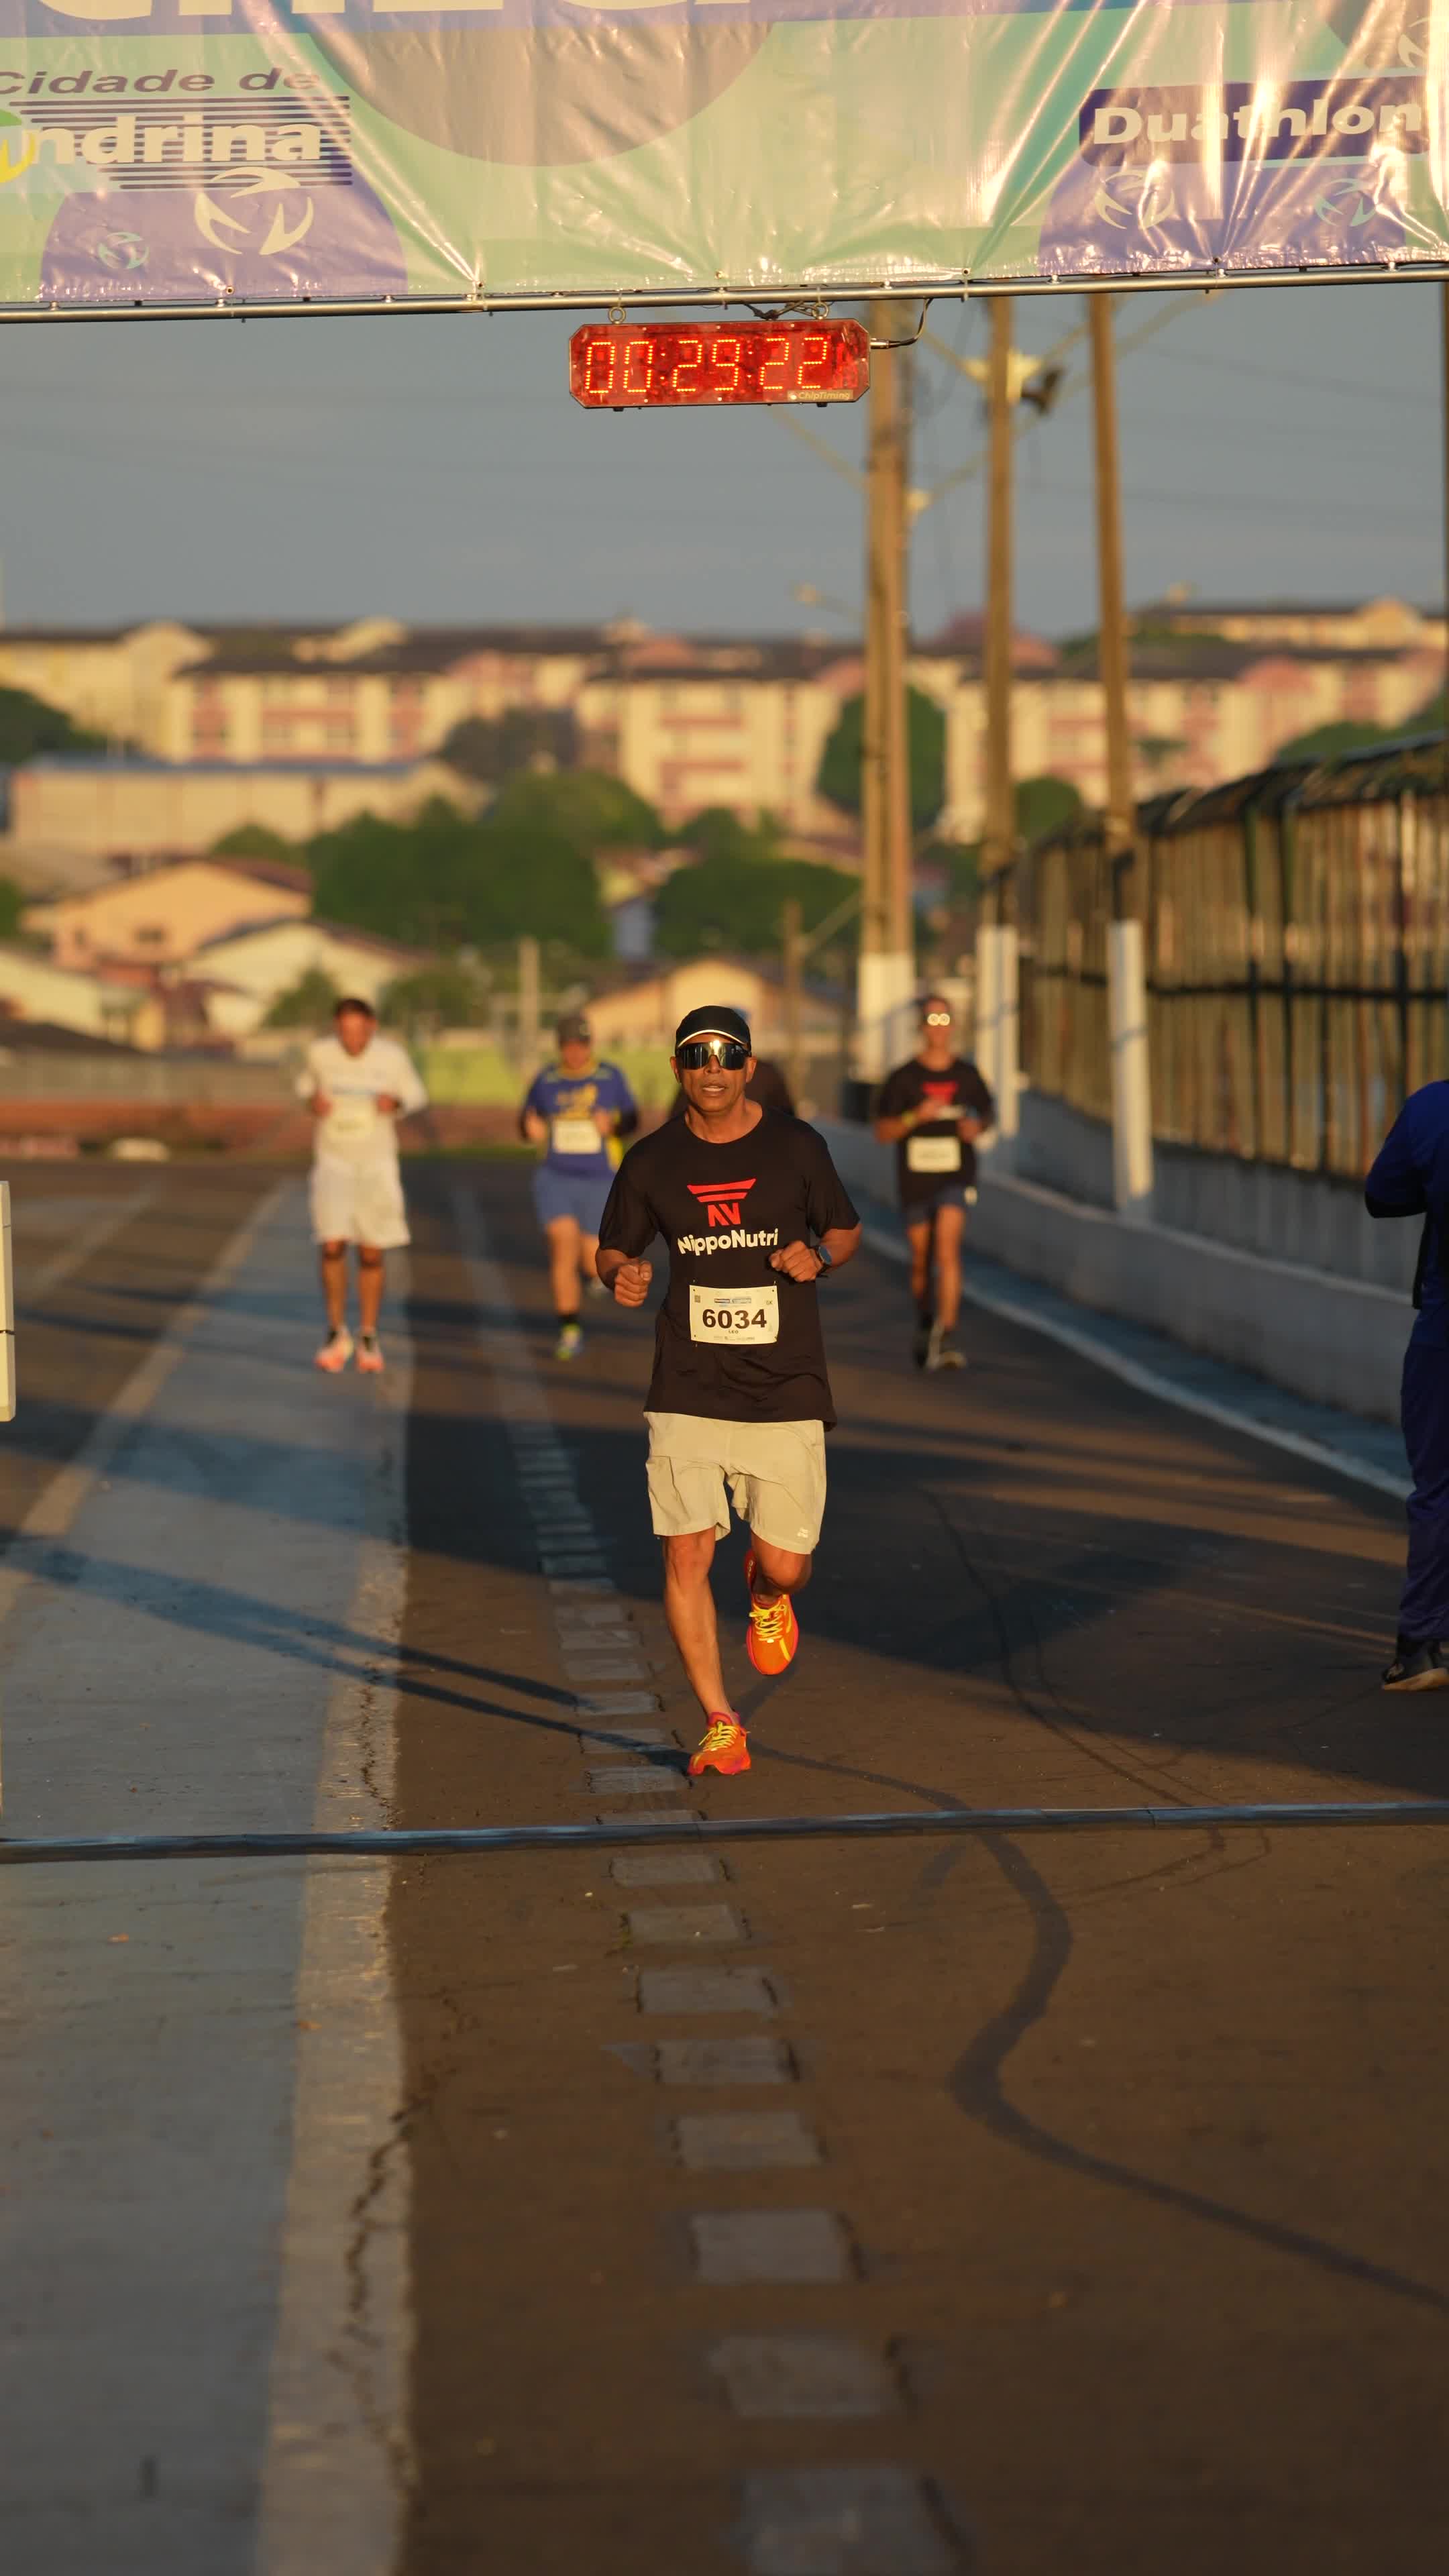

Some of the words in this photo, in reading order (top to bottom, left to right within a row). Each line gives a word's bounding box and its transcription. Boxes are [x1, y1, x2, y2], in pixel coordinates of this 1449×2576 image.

[0, 70, 215, 94] Cidade
[239, 68, 321, 92] de
[1092, 99, 1423, 145] Duathlon
[584, 336, 828, 394] 00:29:22
[677, 1228, 779, 1256] NippoNutri
[702, 1309, 767, 1330] 6034
